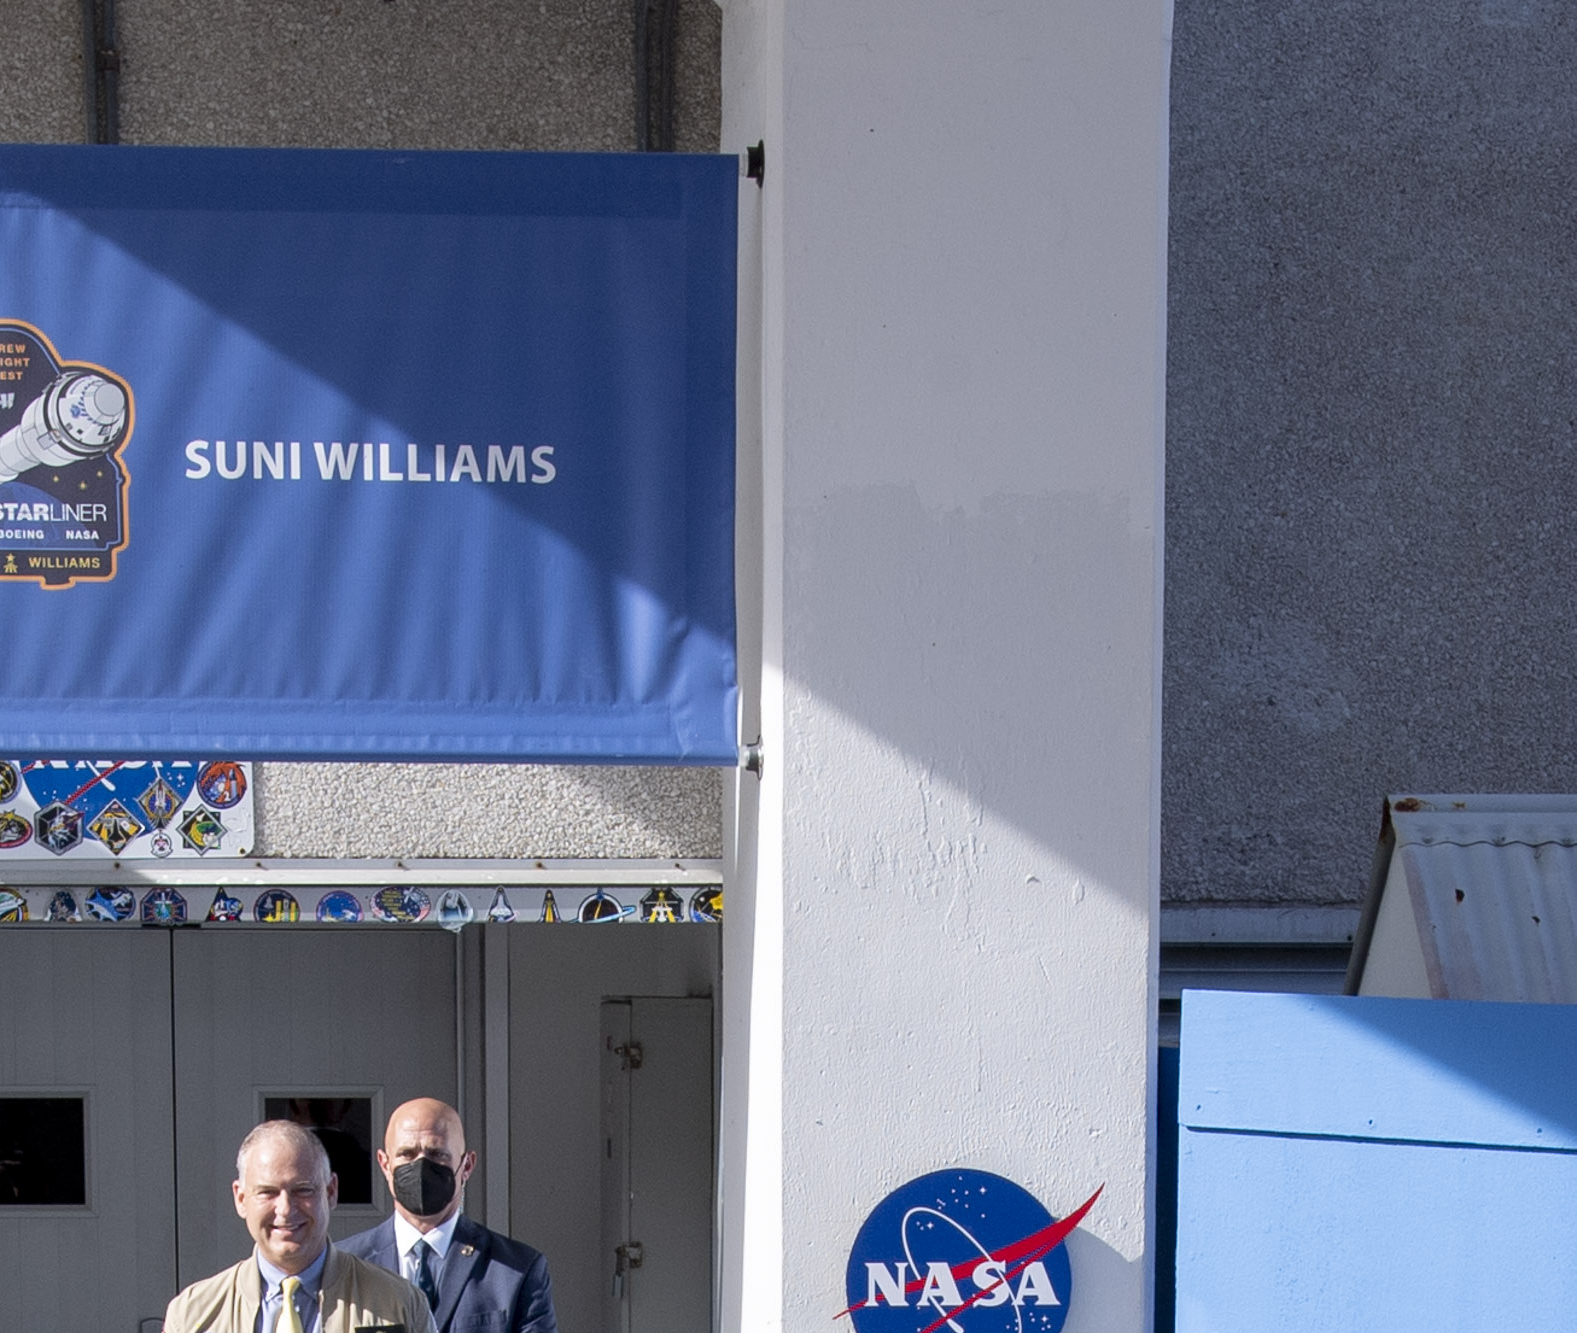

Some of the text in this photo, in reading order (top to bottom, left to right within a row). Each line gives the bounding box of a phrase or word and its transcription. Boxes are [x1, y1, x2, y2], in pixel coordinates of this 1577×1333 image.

[185, 439, 557, 485] SUNI WILLIAMS
[66, 530, 100, 541] NASA
[29, 556, 101, 570] WILLIAMS
[863, 1260, 1061, 1307] NASA
